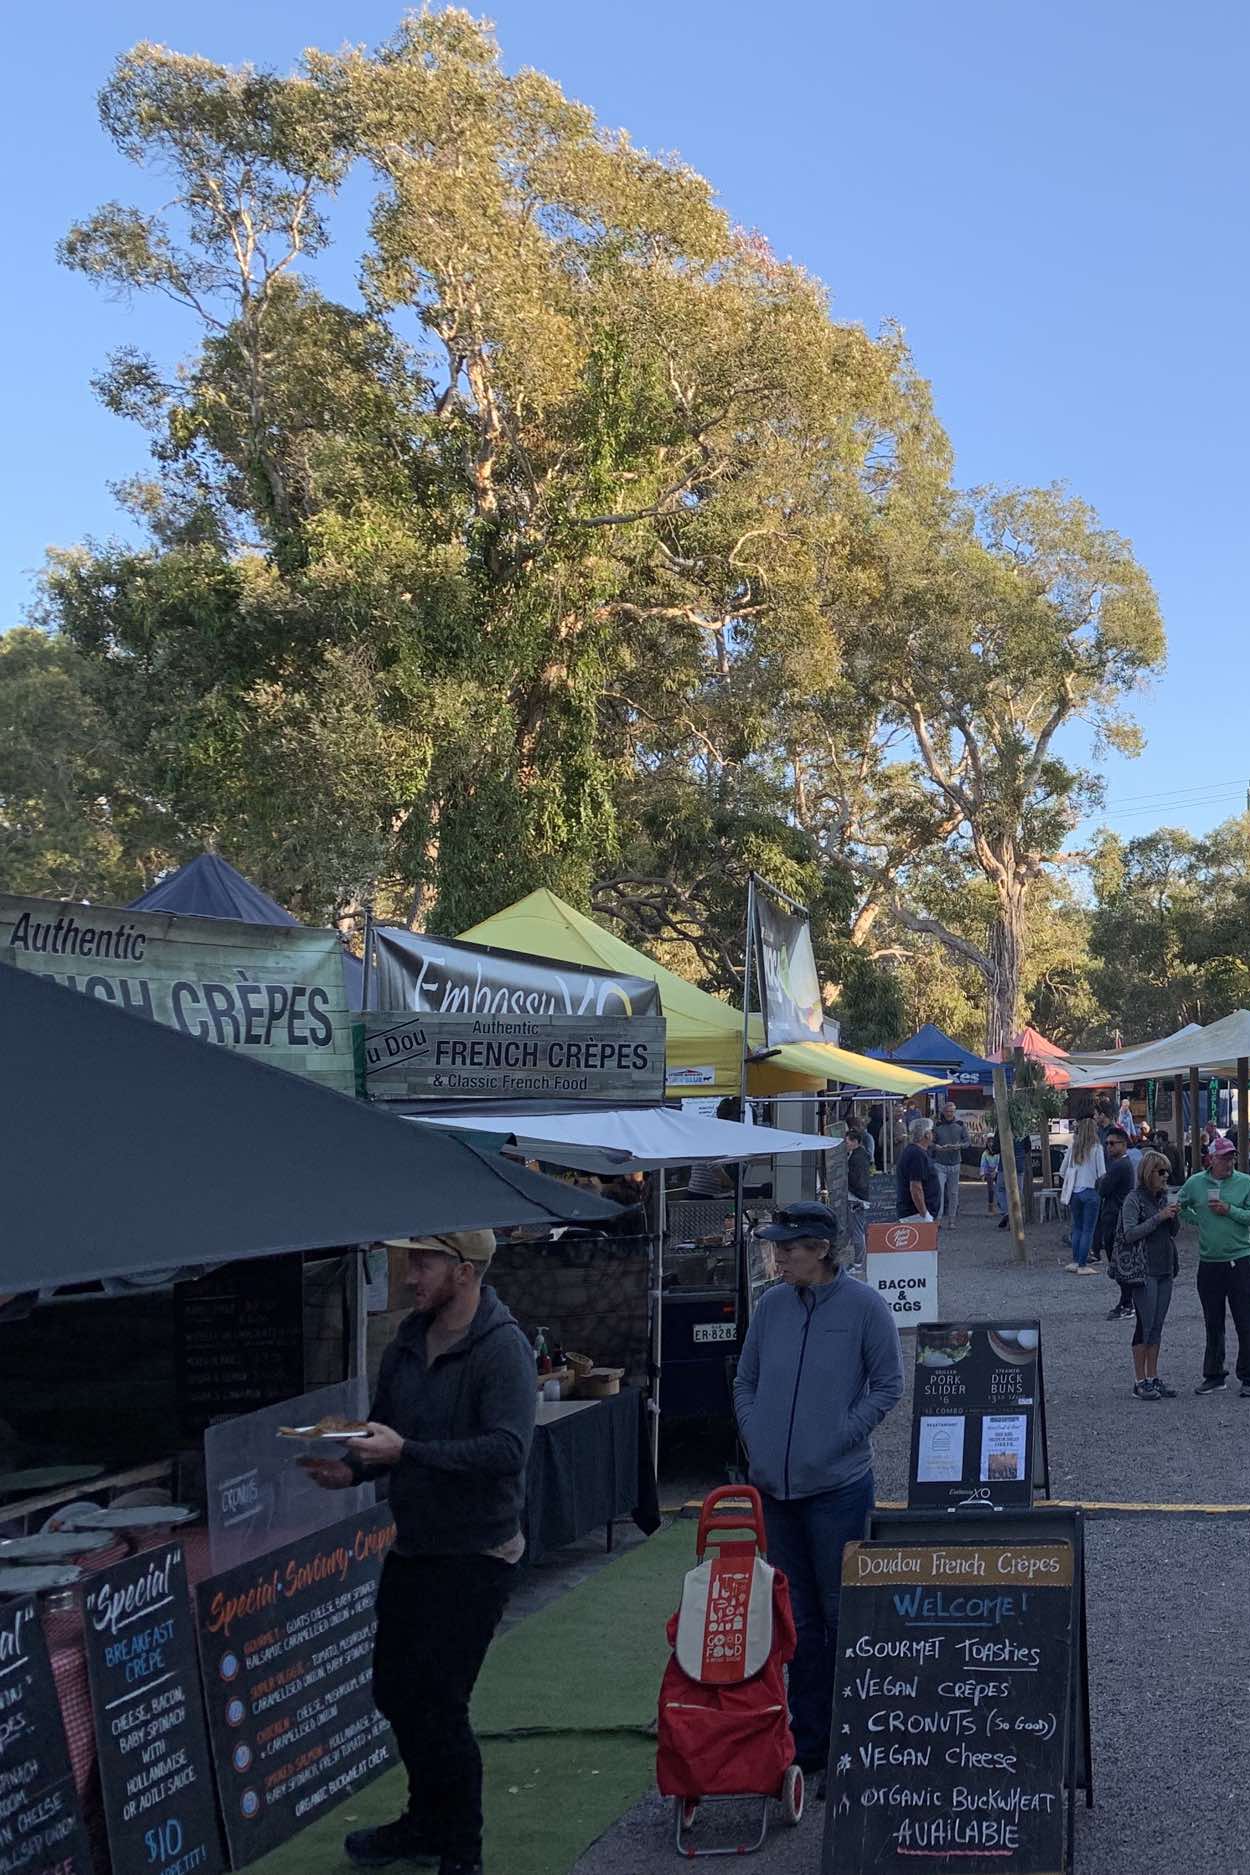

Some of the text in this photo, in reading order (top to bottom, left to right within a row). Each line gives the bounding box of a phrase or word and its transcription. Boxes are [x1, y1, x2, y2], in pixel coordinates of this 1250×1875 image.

[9, 912, 146, 961] Authentic
[171, 968, 333, 1047] CRÈPES
[472, 1020, 540, 1036] Authentic
[384, 1028, 427, 1058] Dou
[434, 1037, 649, 1070] FRENCH CRÈPES
[432, 1073, 588, 1091] & Classic French Food
[878, 1278, 927, 1291] BACON
[897, 1290, 908, 1301] &
[924, 1384, 967, 1395] SLIDER
[929, 1375, 962, 1385] PORK
[990, 1383, 1024, 1394] BUNS
[991, 1373, 1024, 1384] DUCK
[857, 1552, 921, 1577] Doudou
[931, 1552, 985, 1577] French
[207, 1569, 279, 1638] Special
[104, 1617, 175, 1667] BREAKFAST
[855, 1635, 945, 1665] GOURMET
[855, 1667, 919, 1701] VEGAN
[867, 1709, 977, 1736] CRONUTS
[119, 1728, 145, 1754] BABY
[141, 1738, 167, 1764] WITH
[858, 1741, 932, 1772] VEGAN
[123, 1800, 138, 1821] OR
[144, 1817, 183, 1864] $10
